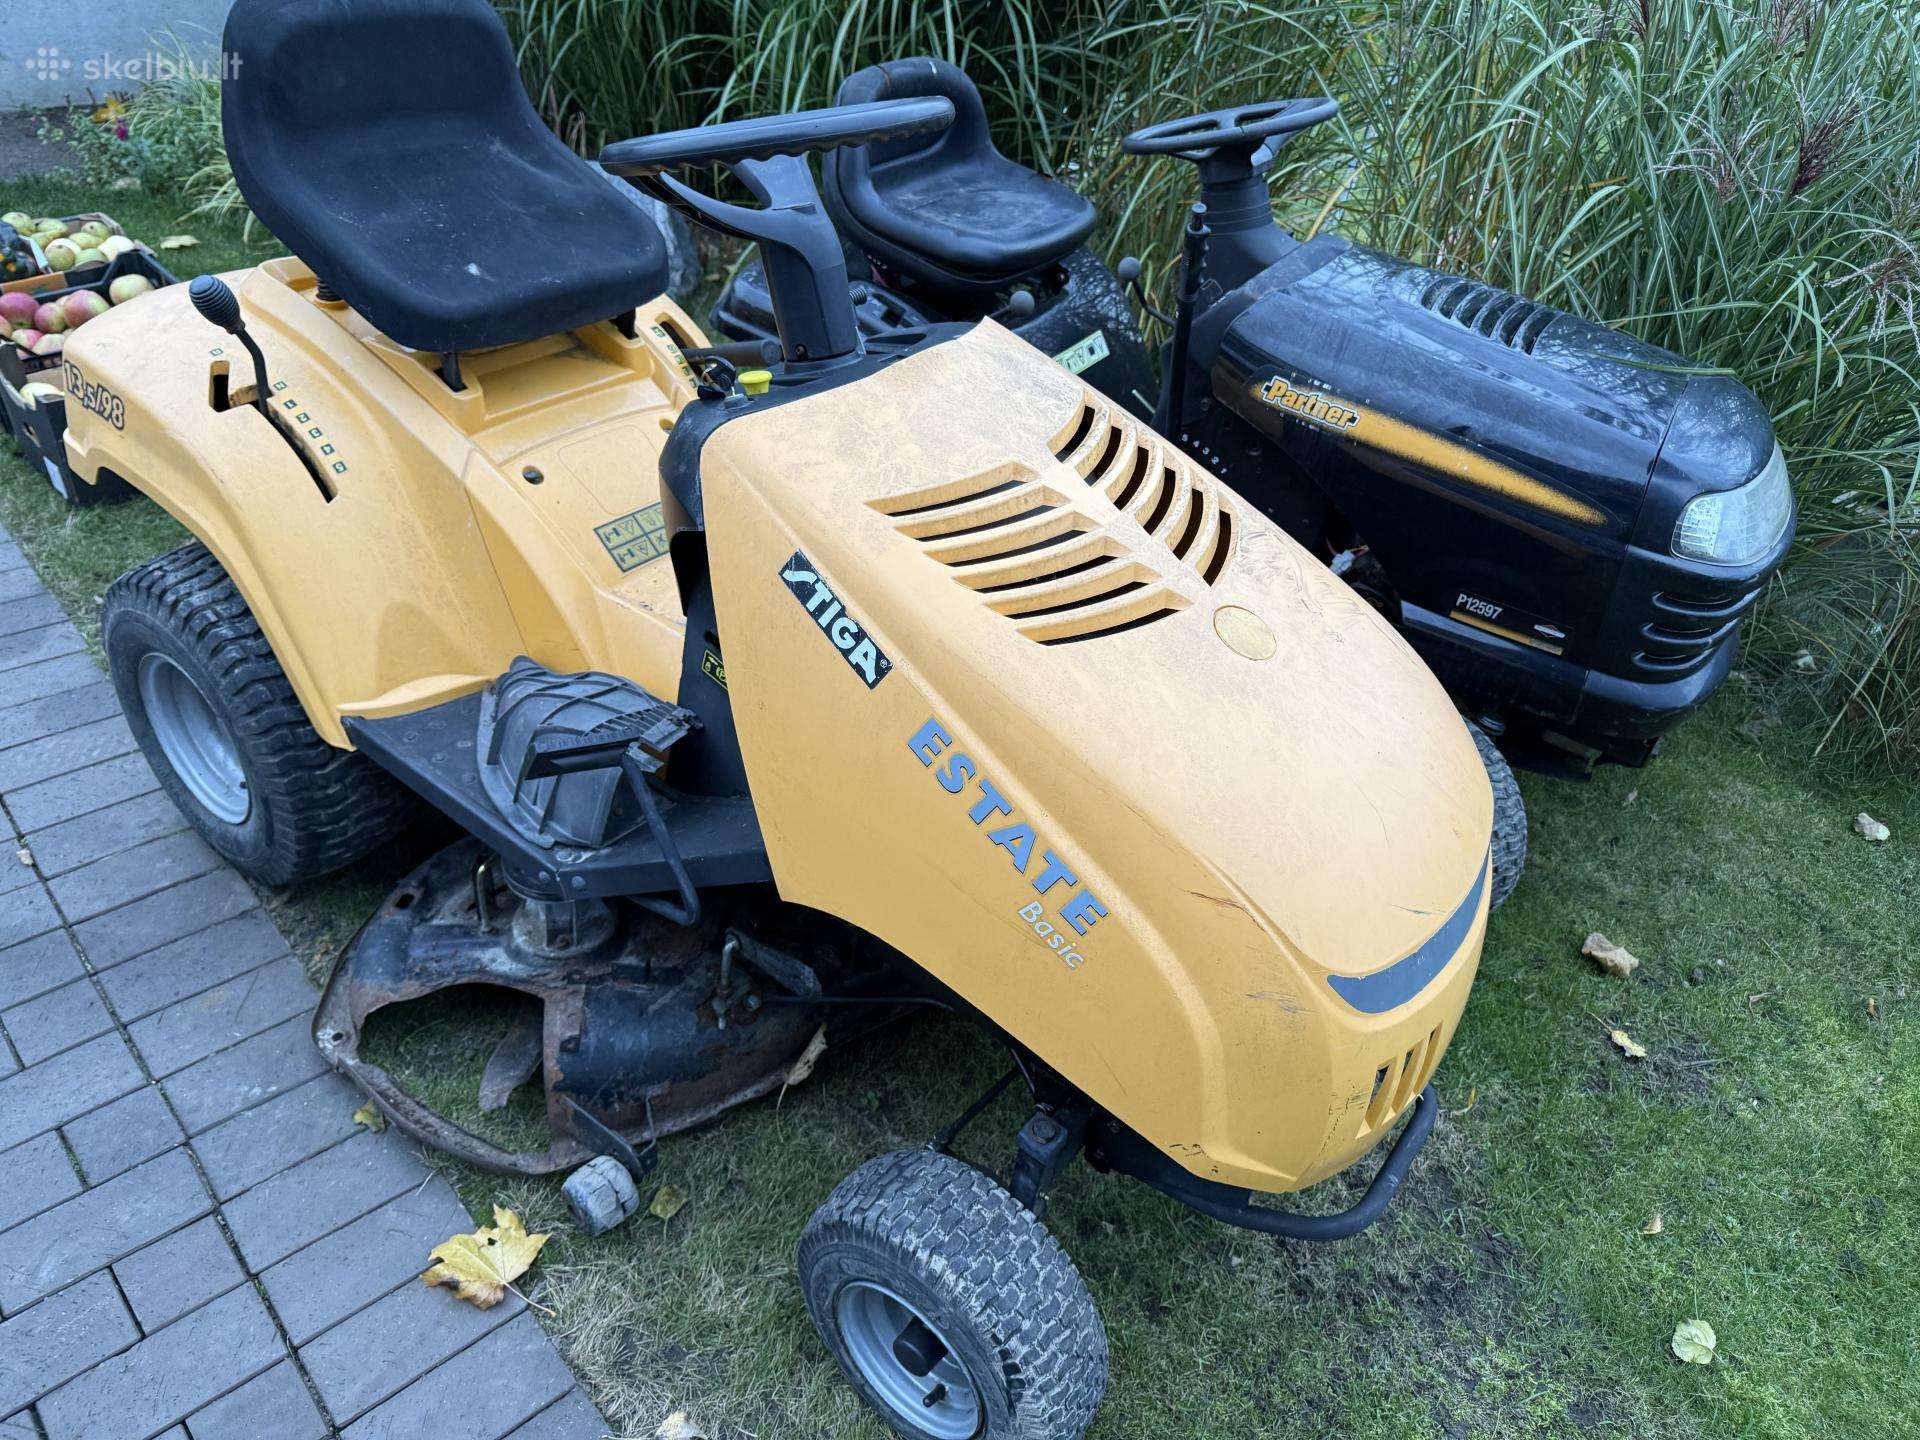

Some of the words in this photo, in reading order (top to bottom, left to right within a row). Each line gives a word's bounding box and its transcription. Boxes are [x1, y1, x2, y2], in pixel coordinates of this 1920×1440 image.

[64, 360, 125, 430] 13,5/98
[1261, 375, 1360, 431] Partner
[782, 569, 878, 684] STIGA
[1455, 593, 1504, 620] P12597
[907, 716, 1109, 937] ESTATE
[1017, 900, 1085, 971] Basic
